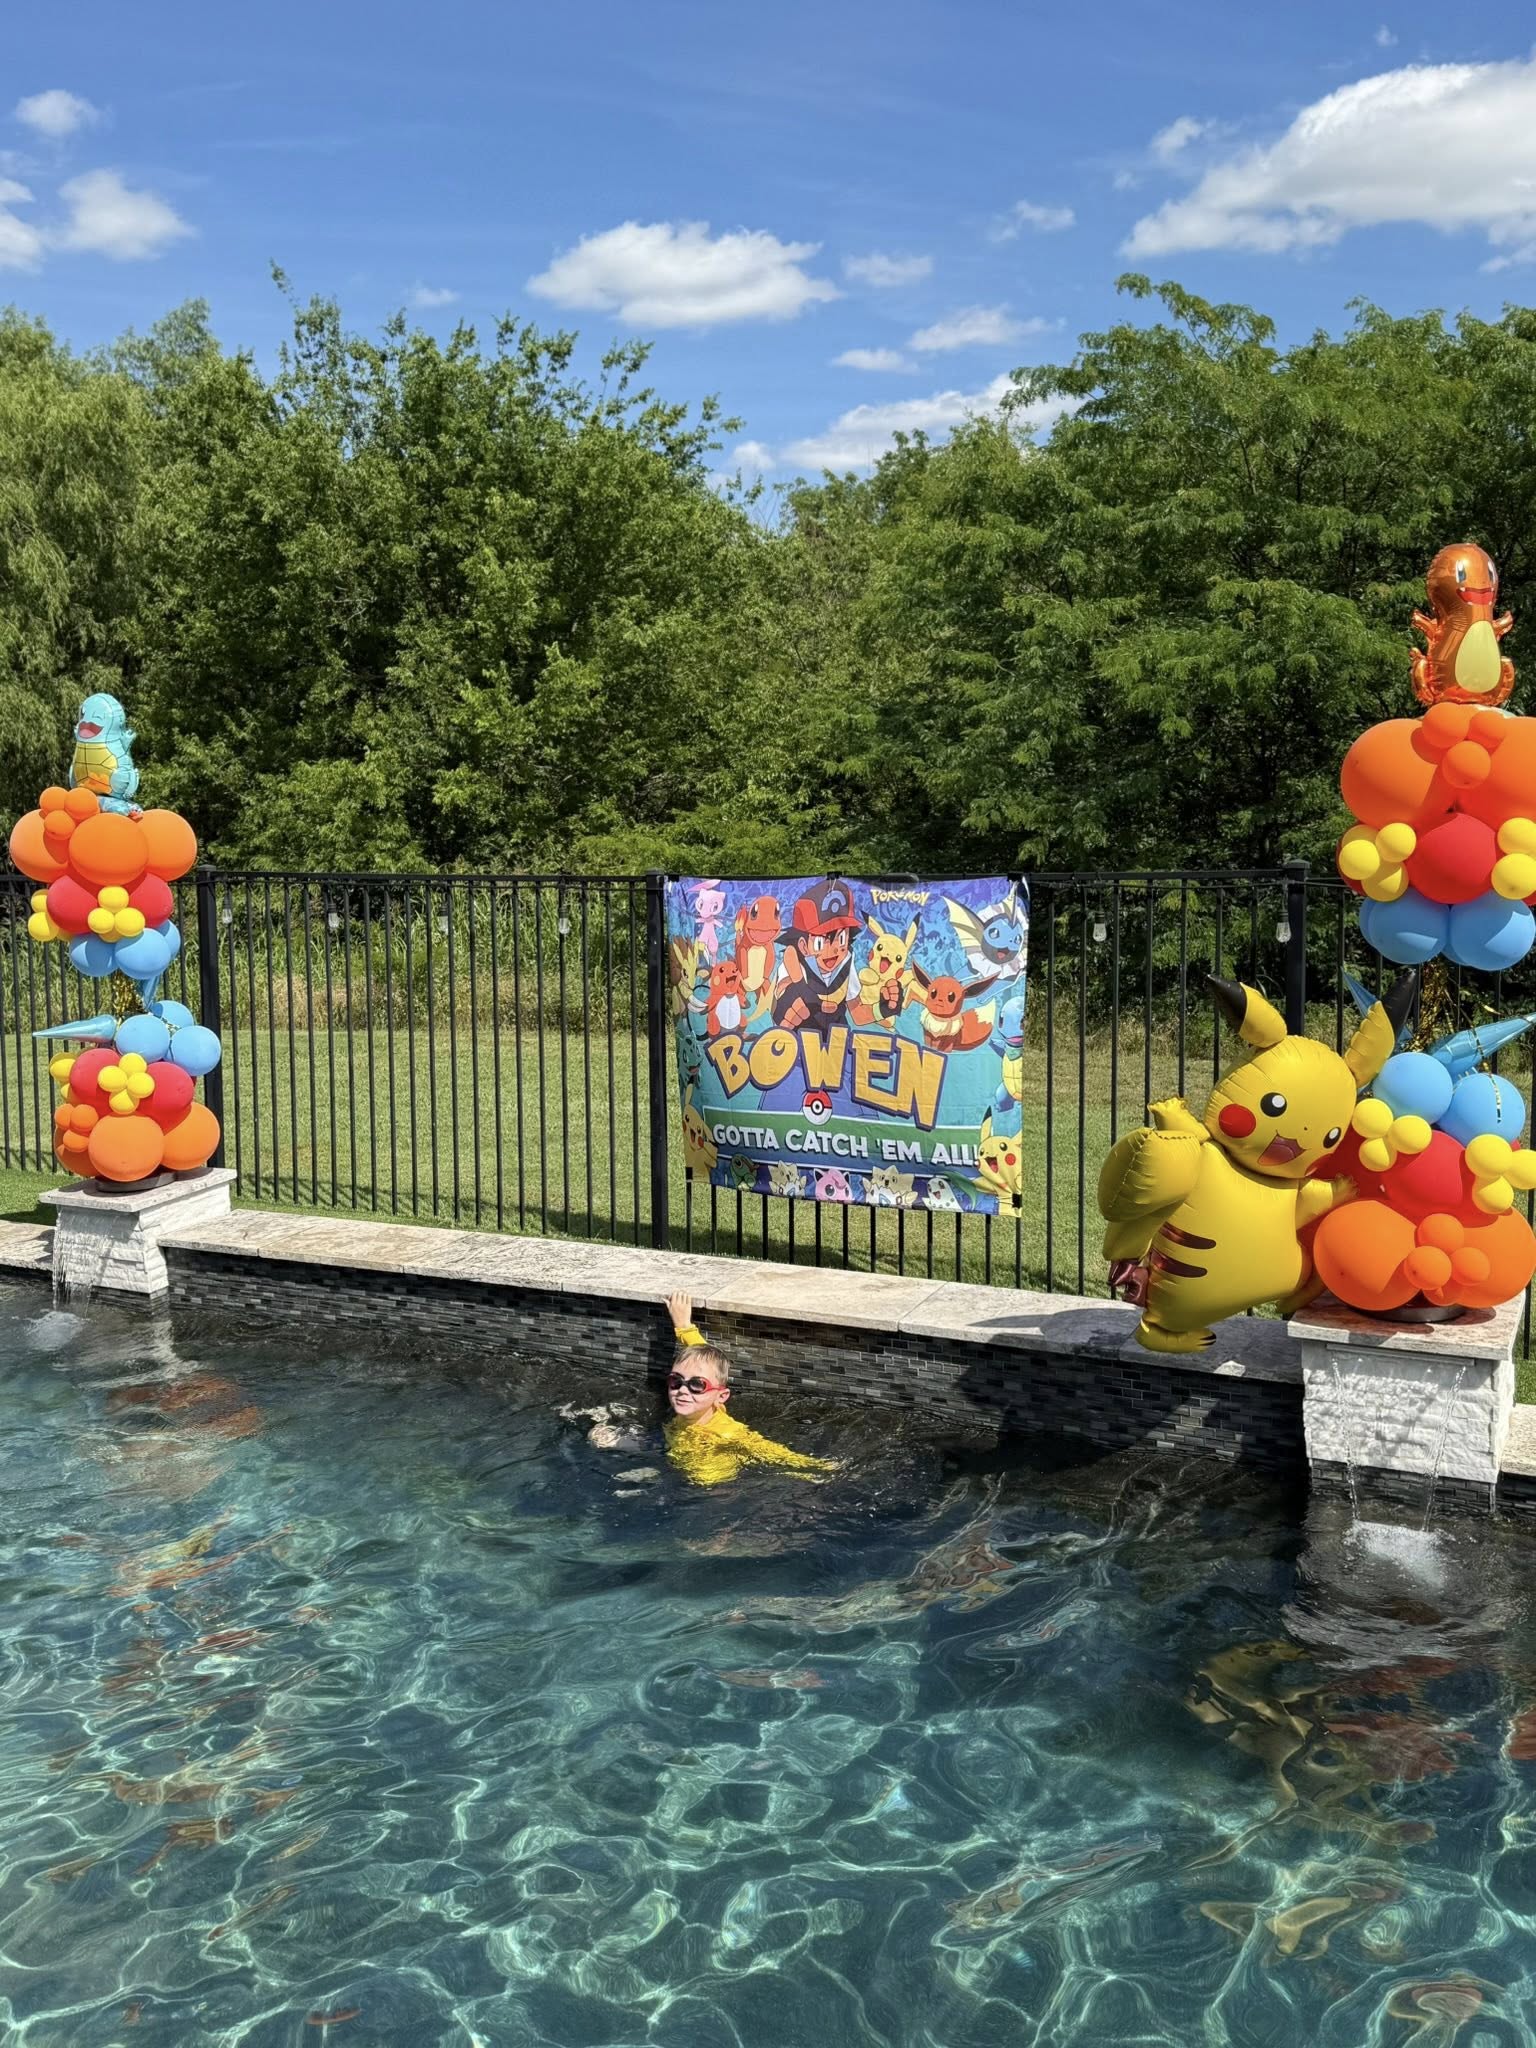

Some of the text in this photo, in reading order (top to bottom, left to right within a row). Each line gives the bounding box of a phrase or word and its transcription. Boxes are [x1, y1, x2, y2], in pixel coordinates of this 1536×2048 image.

[705, 1024, 948, 1132] BOWEN
[712, 1124, 980, 1167] GOTTA CATCH 'EM ALL!
